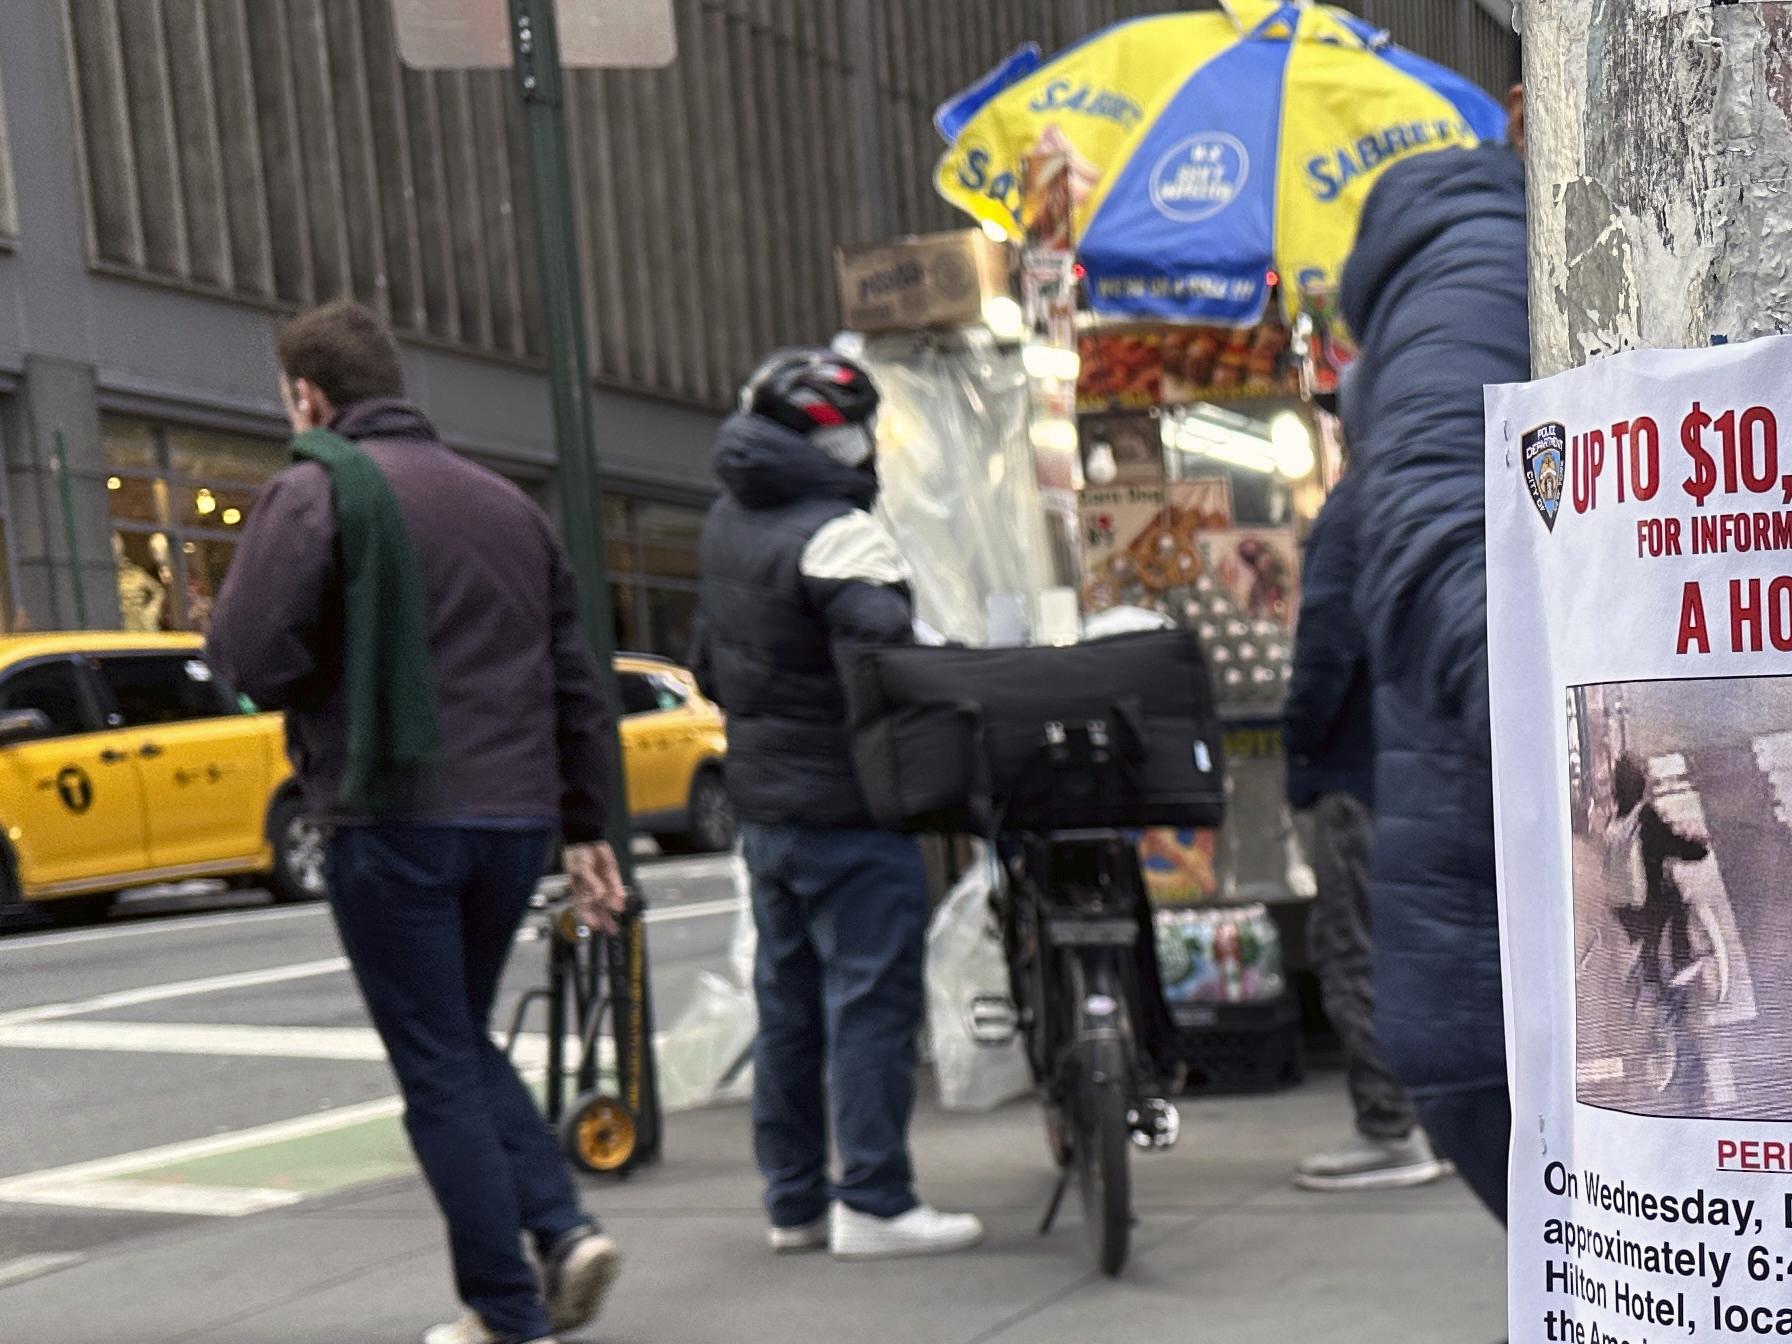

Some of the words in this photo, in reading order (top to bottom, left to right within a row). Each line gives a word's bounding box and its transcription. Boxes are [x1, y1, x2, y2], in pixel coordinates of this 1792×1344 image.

[1526, 471, 1539, 496] CITY
[1571, 431, 1603, 515] UP
[1611, 416, 1660, 503] TO
[1637, 519, 1681, 559] FOR
[1676, 581, 1711, 655] A
[1544, 1161, 1578, 1199] On
[1584, 1169, 1763, 1236] Wednesday,
[1544, 1218, 1731, 1287] approximately
[1545, 1260, 1607, 1309] Hilton
[1614, 1280, 1695, 1335] Hotel,
